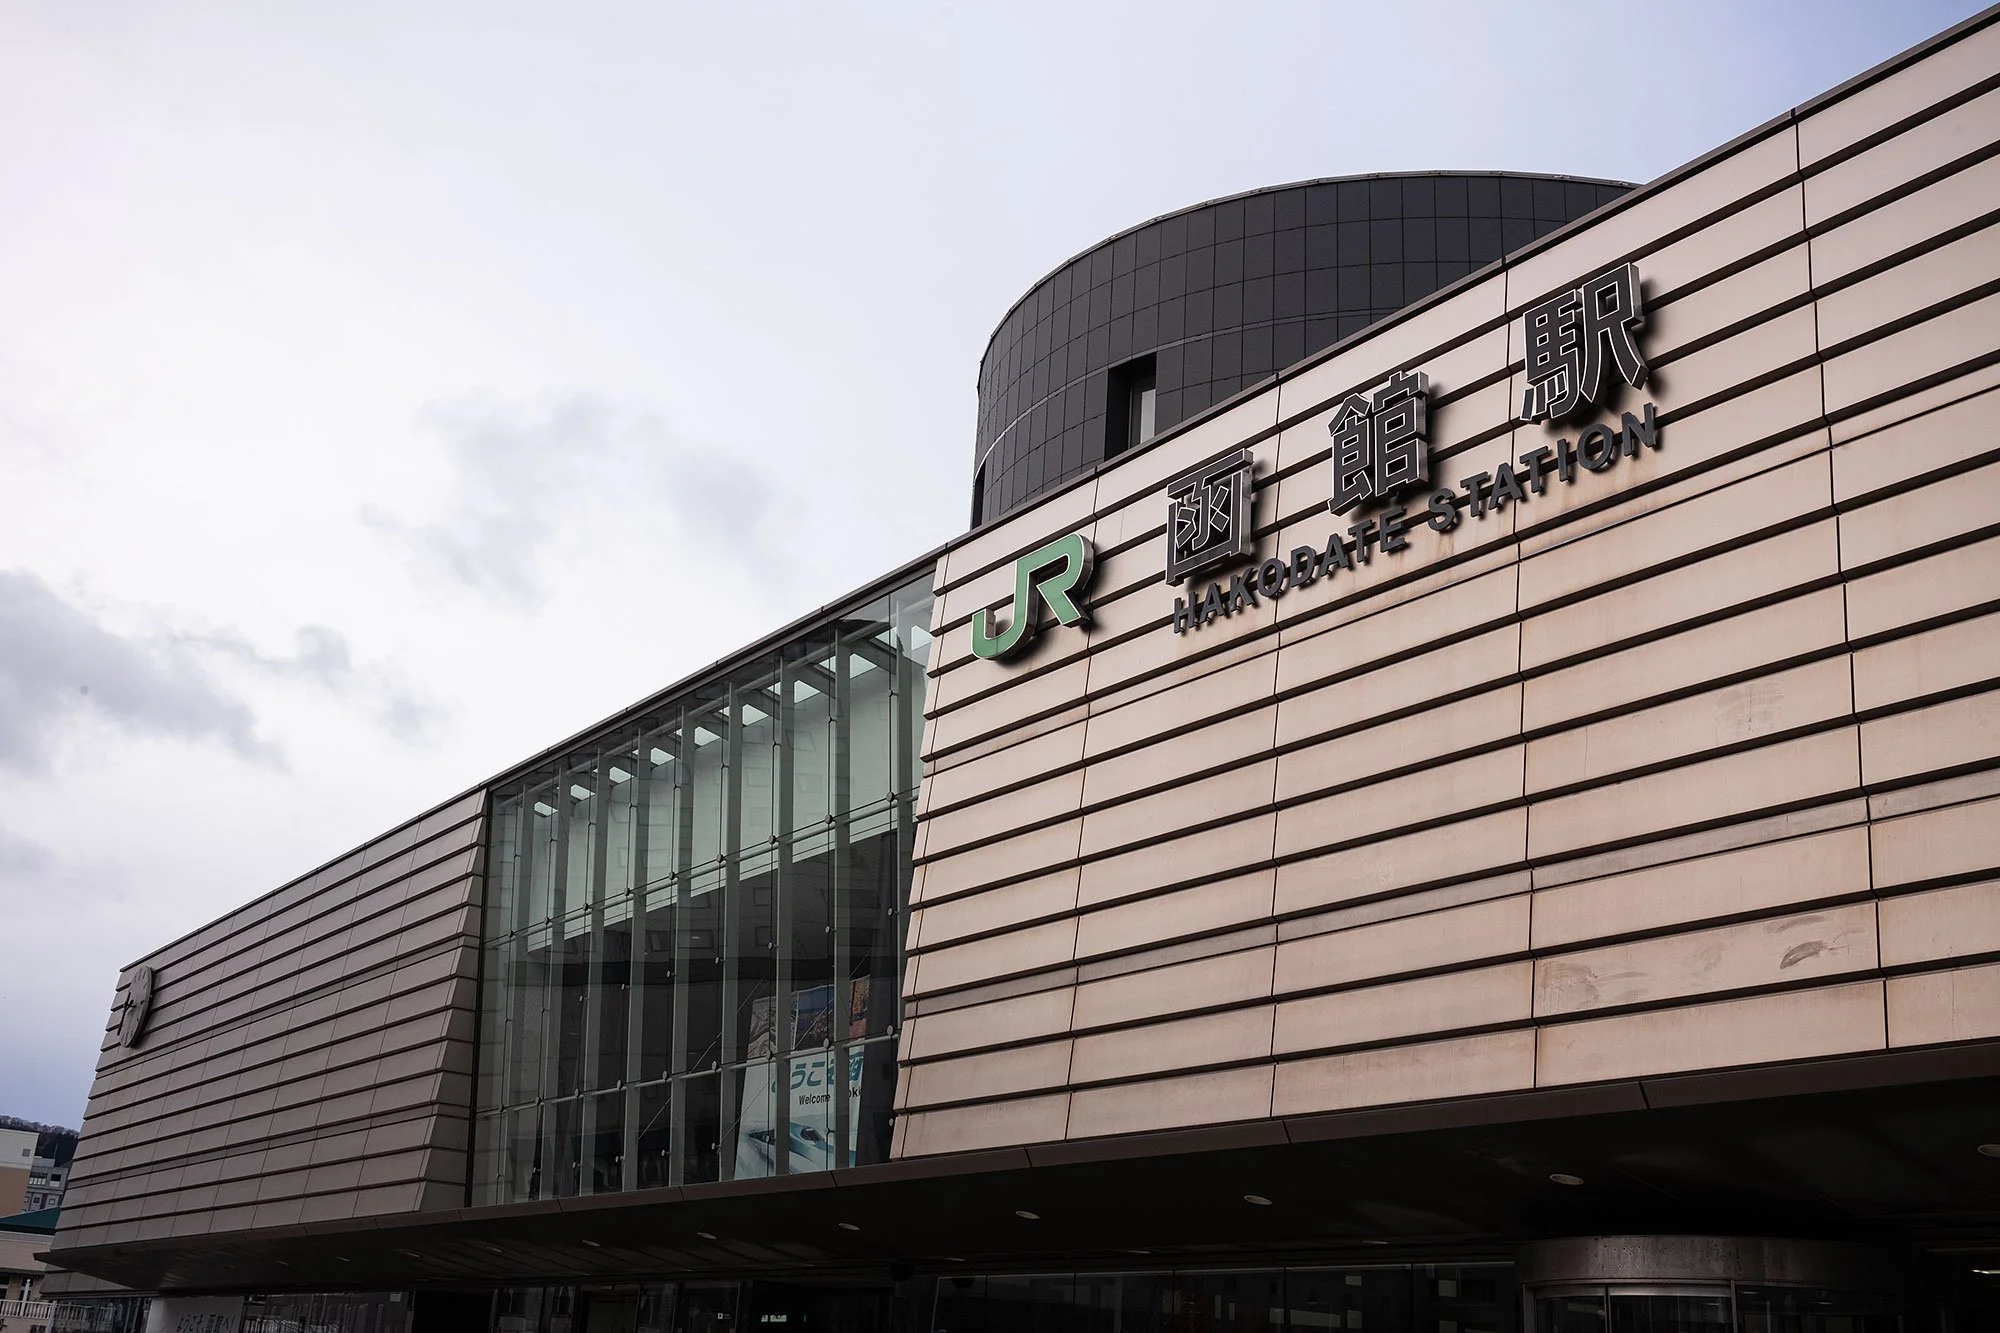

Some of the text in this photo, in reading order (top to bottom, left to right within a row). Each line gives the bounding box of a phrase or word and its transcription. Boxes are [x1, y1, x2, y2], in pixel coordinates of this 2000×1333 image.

[1165, 262, 1650, 586] 函館駅
[971, 532, 1095, 661] JR
[1173, 403, 1661, 634] HAKODATE STATION
[798, 1093, 831, 1106] Welcome
